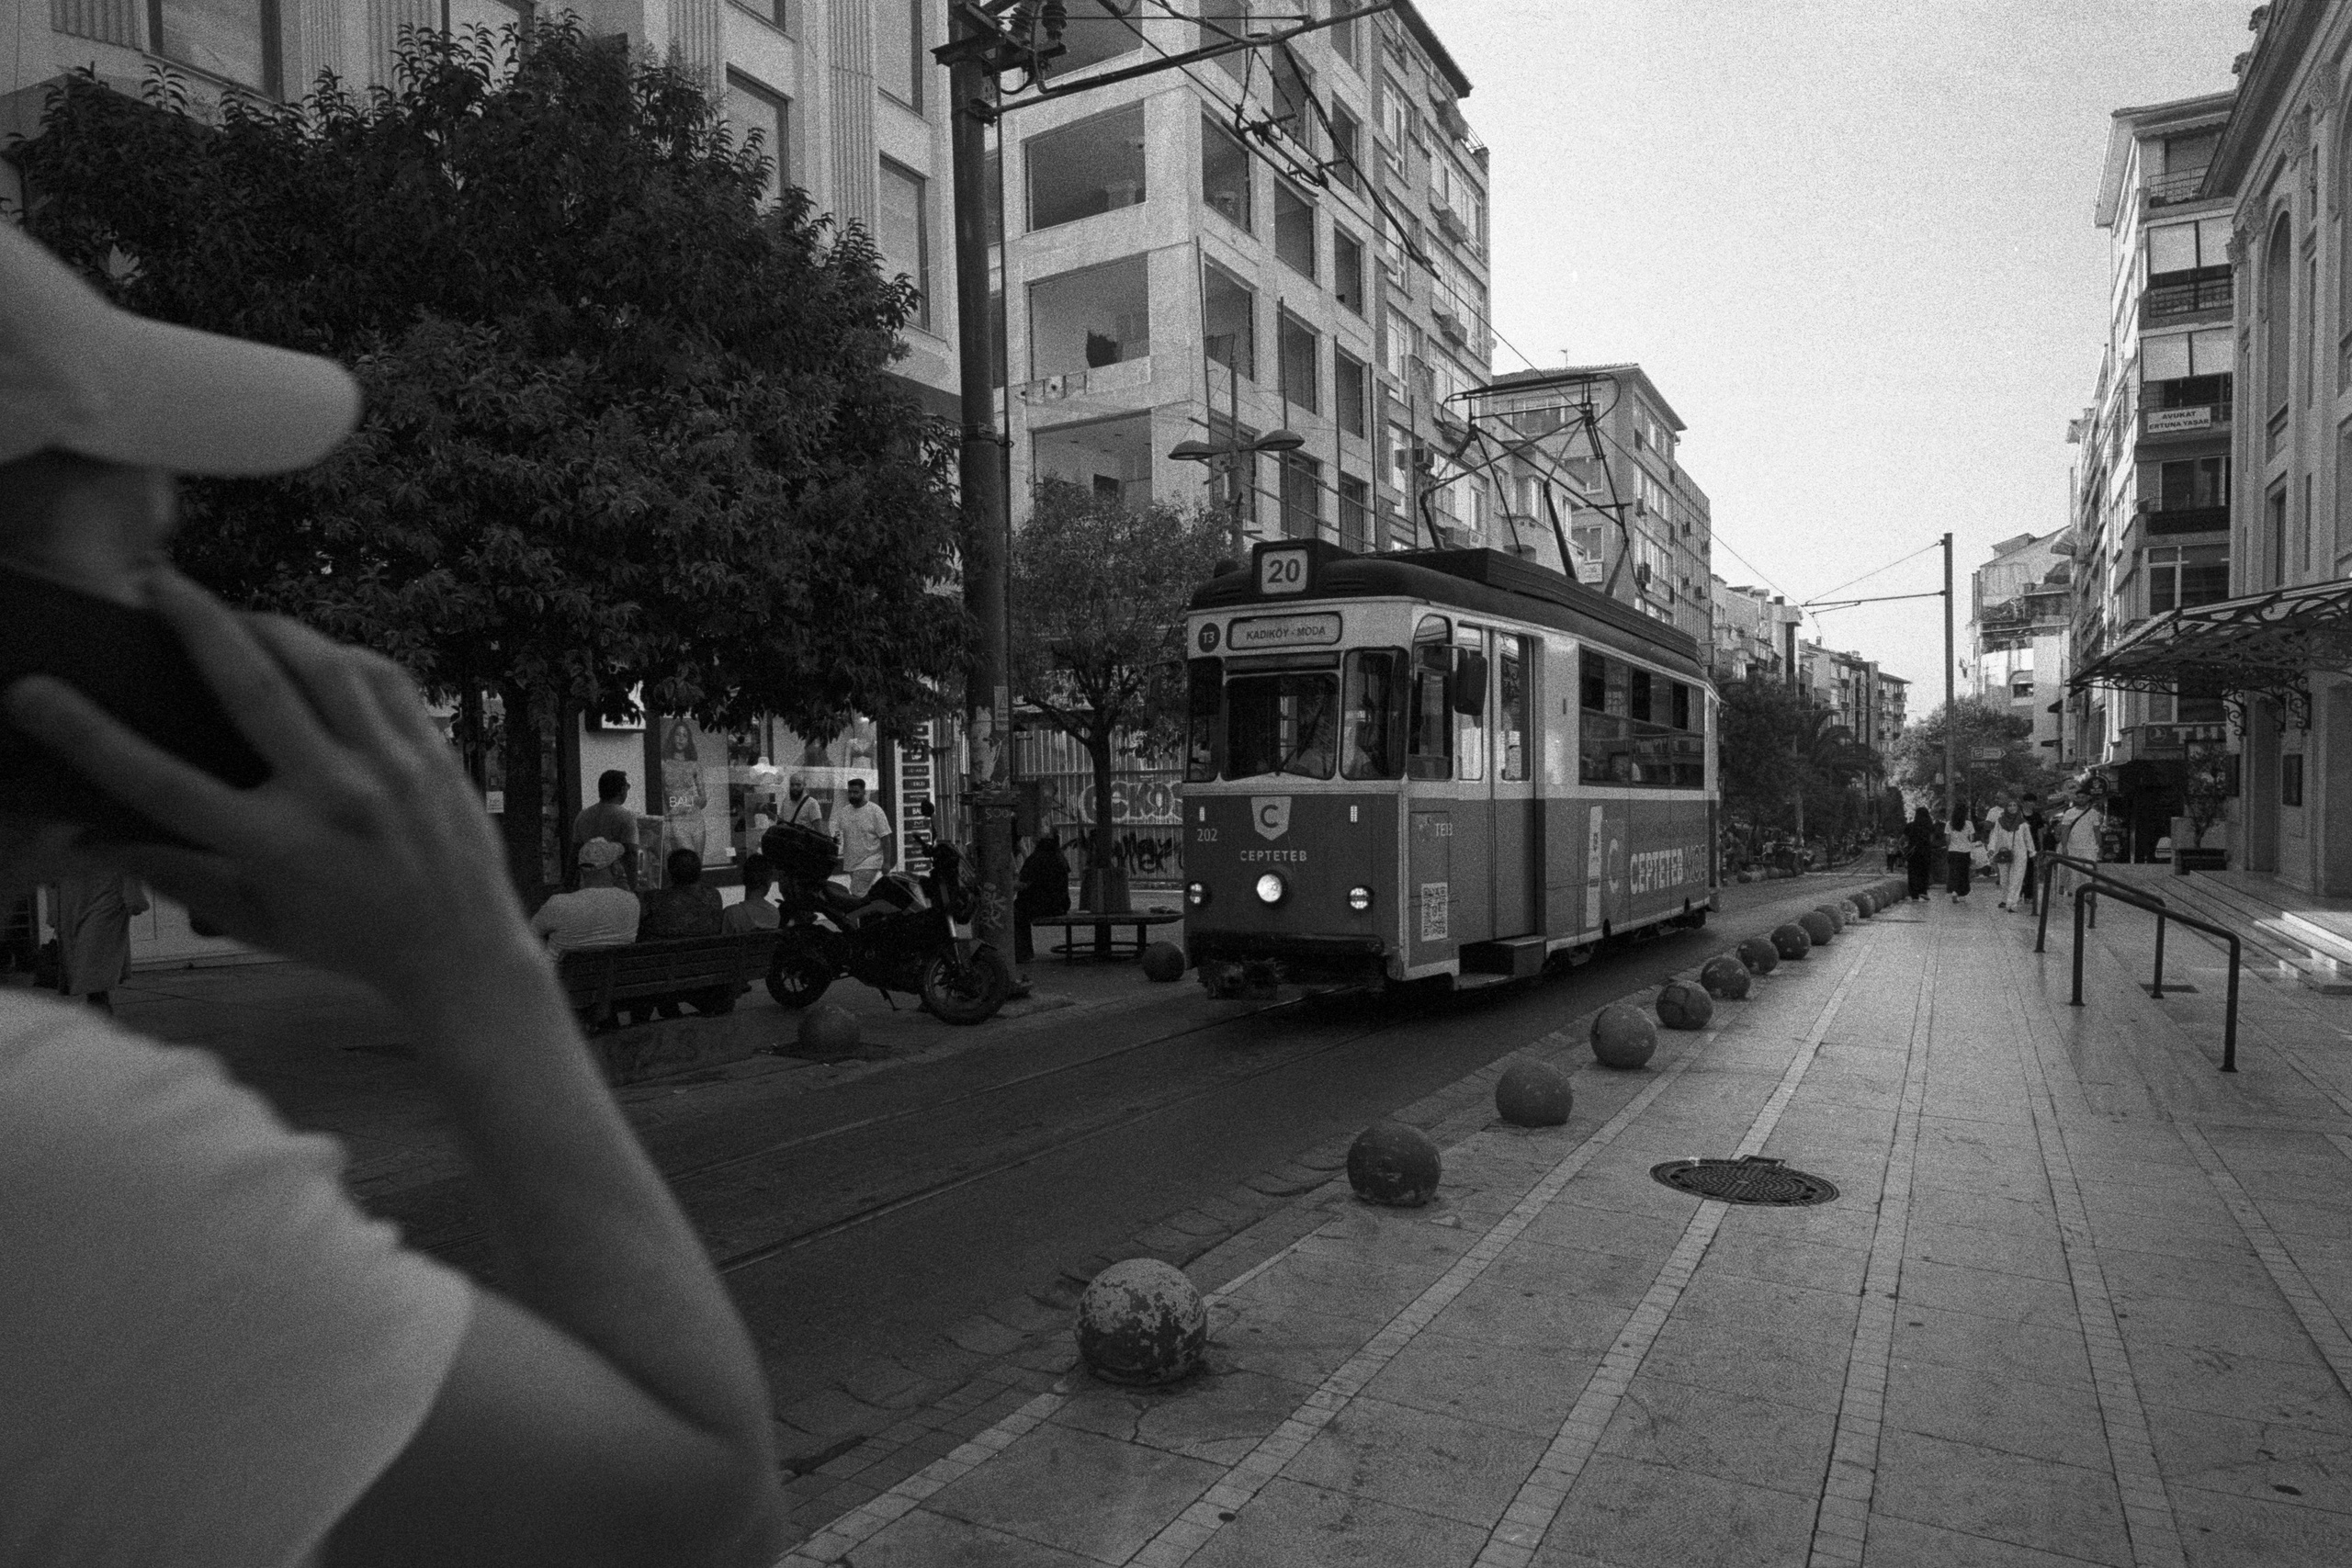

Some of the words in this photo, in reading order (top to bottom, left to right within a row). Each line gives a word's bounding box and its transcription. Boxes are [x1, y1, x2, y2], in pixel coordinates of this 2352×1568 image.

[2163, 411, 2196, 420] AVUKAT
[1267, 558, 1301, 583] 20
[1202, 631, 1215, 643] T3
[1246, 626, 1289, 640] KADIKÖY
[1296, 626, 1326, 637] MODA
[1260, 804, 1279, 828] C
[1197, 829, 1217, 842] 202
[1434, 822, 1453, 837] TEB
[1240, 851, 1307, 862] CEPTETEB
[1630, 848, 1683, 895] CEPTETEB
